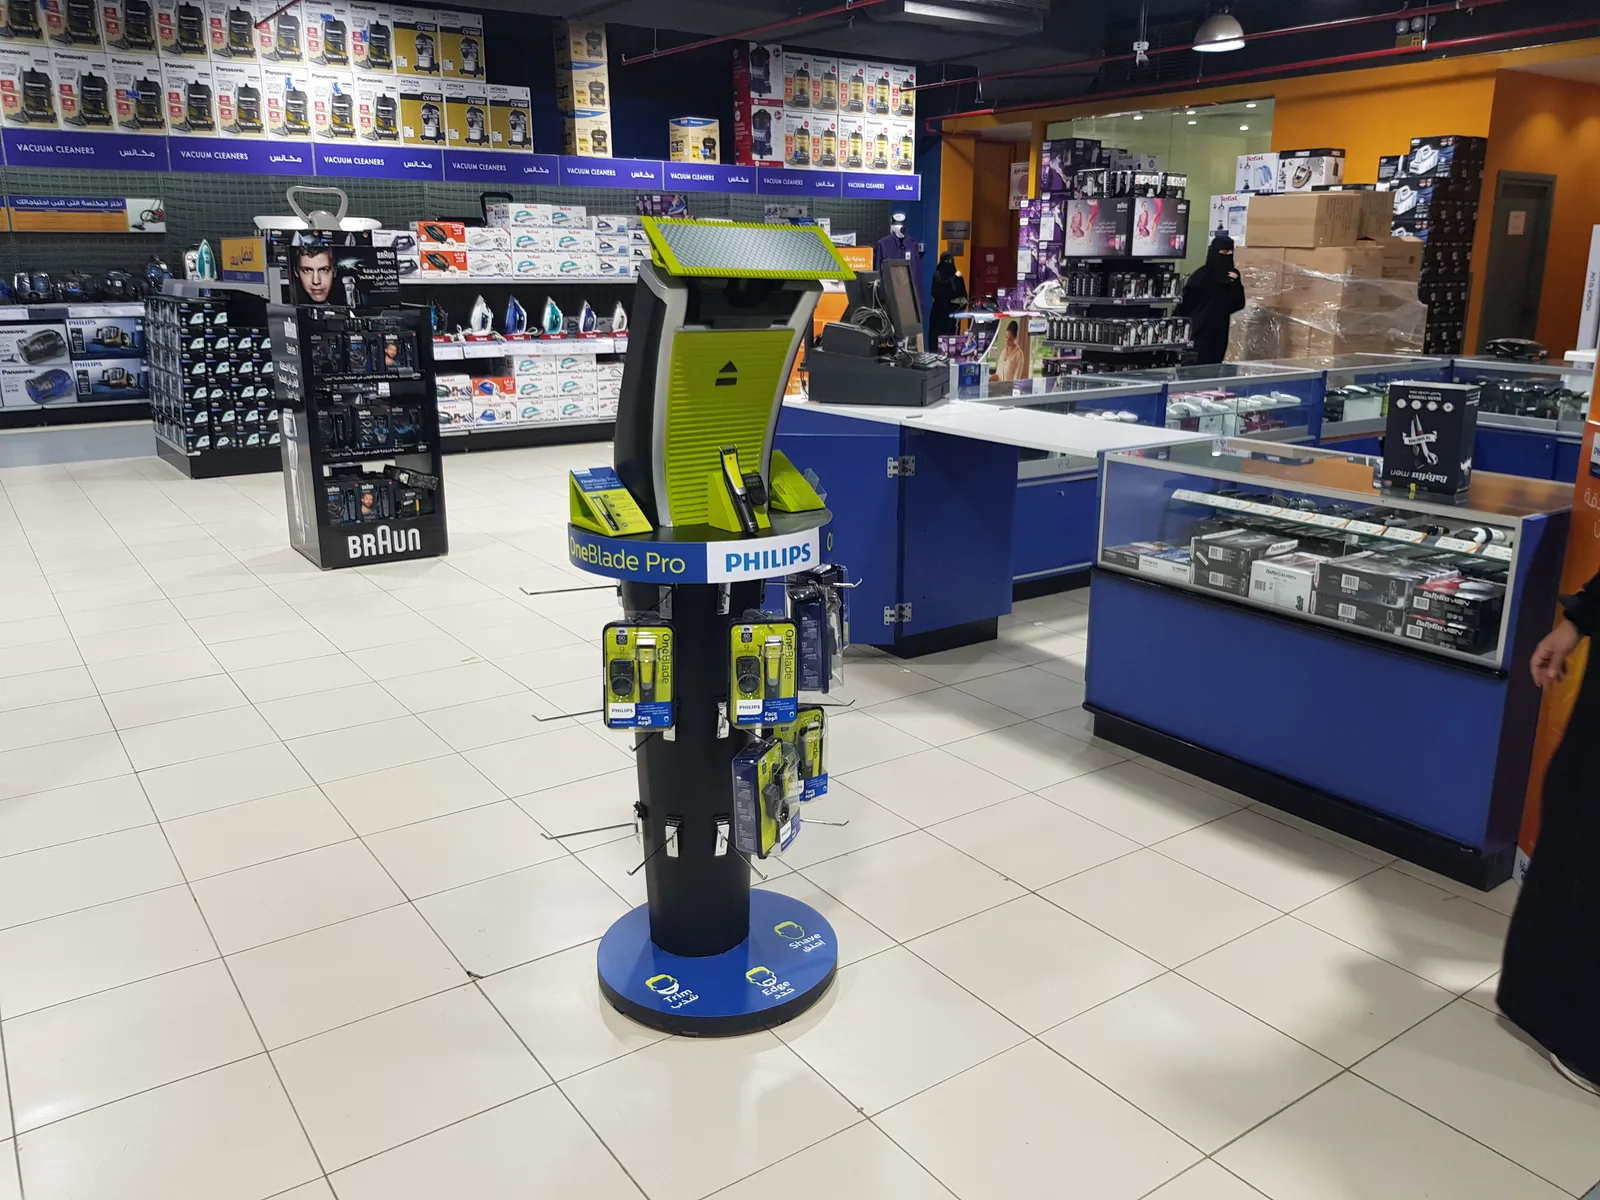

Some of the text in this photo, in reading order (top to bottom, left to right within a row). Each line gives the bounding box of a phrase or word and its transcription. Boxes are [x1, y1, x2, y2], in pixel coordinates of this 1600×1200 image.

[350, 3, 377, 11] Panasonic
[0, 49, 30, 57] anasonic
[54, 52, 89, 62] Panasonic
[111, 58, 144, 67] Panasonic
[164, 62, 195, 71] Panasonic
[215, 66, 245, 74] Panasonic
[265, 69, 293, 77] Panasonic
[312, 73, 339, 81] Panasonic
[357, 76, 383, 84] Panasonic
[17, 143, 95, 156] VACUUM CLEANERS
[119, 148, 156, 159] مكانس
[180, 150, 249, 161] VACUUM CLEANERS
[269, 153, 303, 163] مكانس
[1246, 154, 1265, 163] Tefal
[324, 156, 385, 167] VACUUM CLEANERS
[403, 160, 433, 170] مكانس
[452, 162, 507, 172] VACUUM CLEANERS
[523, 165, 550, 175] مكانس
[567, 167, 616, 177] VACUUM CLEANERS
[631, 170, 655, 179] مكانس
[670, 172, 715, 182] VACUUM CLEANERS
[728, 175, 750, 184] مكانس
[763, 177, 804, 186] VACUUM CLEANERS
[815, 180, 835, 188] مكانس
[866, 182, 885, 190] CLEANERS
[376, 250, 396, 260] BRAUN
[1029, 321, 1046, 330] PHILIPS
[2, 368, 36, 377] Panasonic
[1390, 469, 1448, 484] BaByliss men
[347, 525, 422, 559] BRAUN
[569, 535, 687, 575] OneBlade Pro
[725, 542, 811, 574] PHILIPS
[1422, 590, 1450, 603] BaByliss
[1415, 619, 1443, 631] BaByliss
[661, 633, 671, 685] OneBlade
[784, 629, 795, 680] OneBlade
[788, 932, 821, 949] Shave
[762, 980, 791, 997] Edge
[662, 989, 693, 1004] Trim
